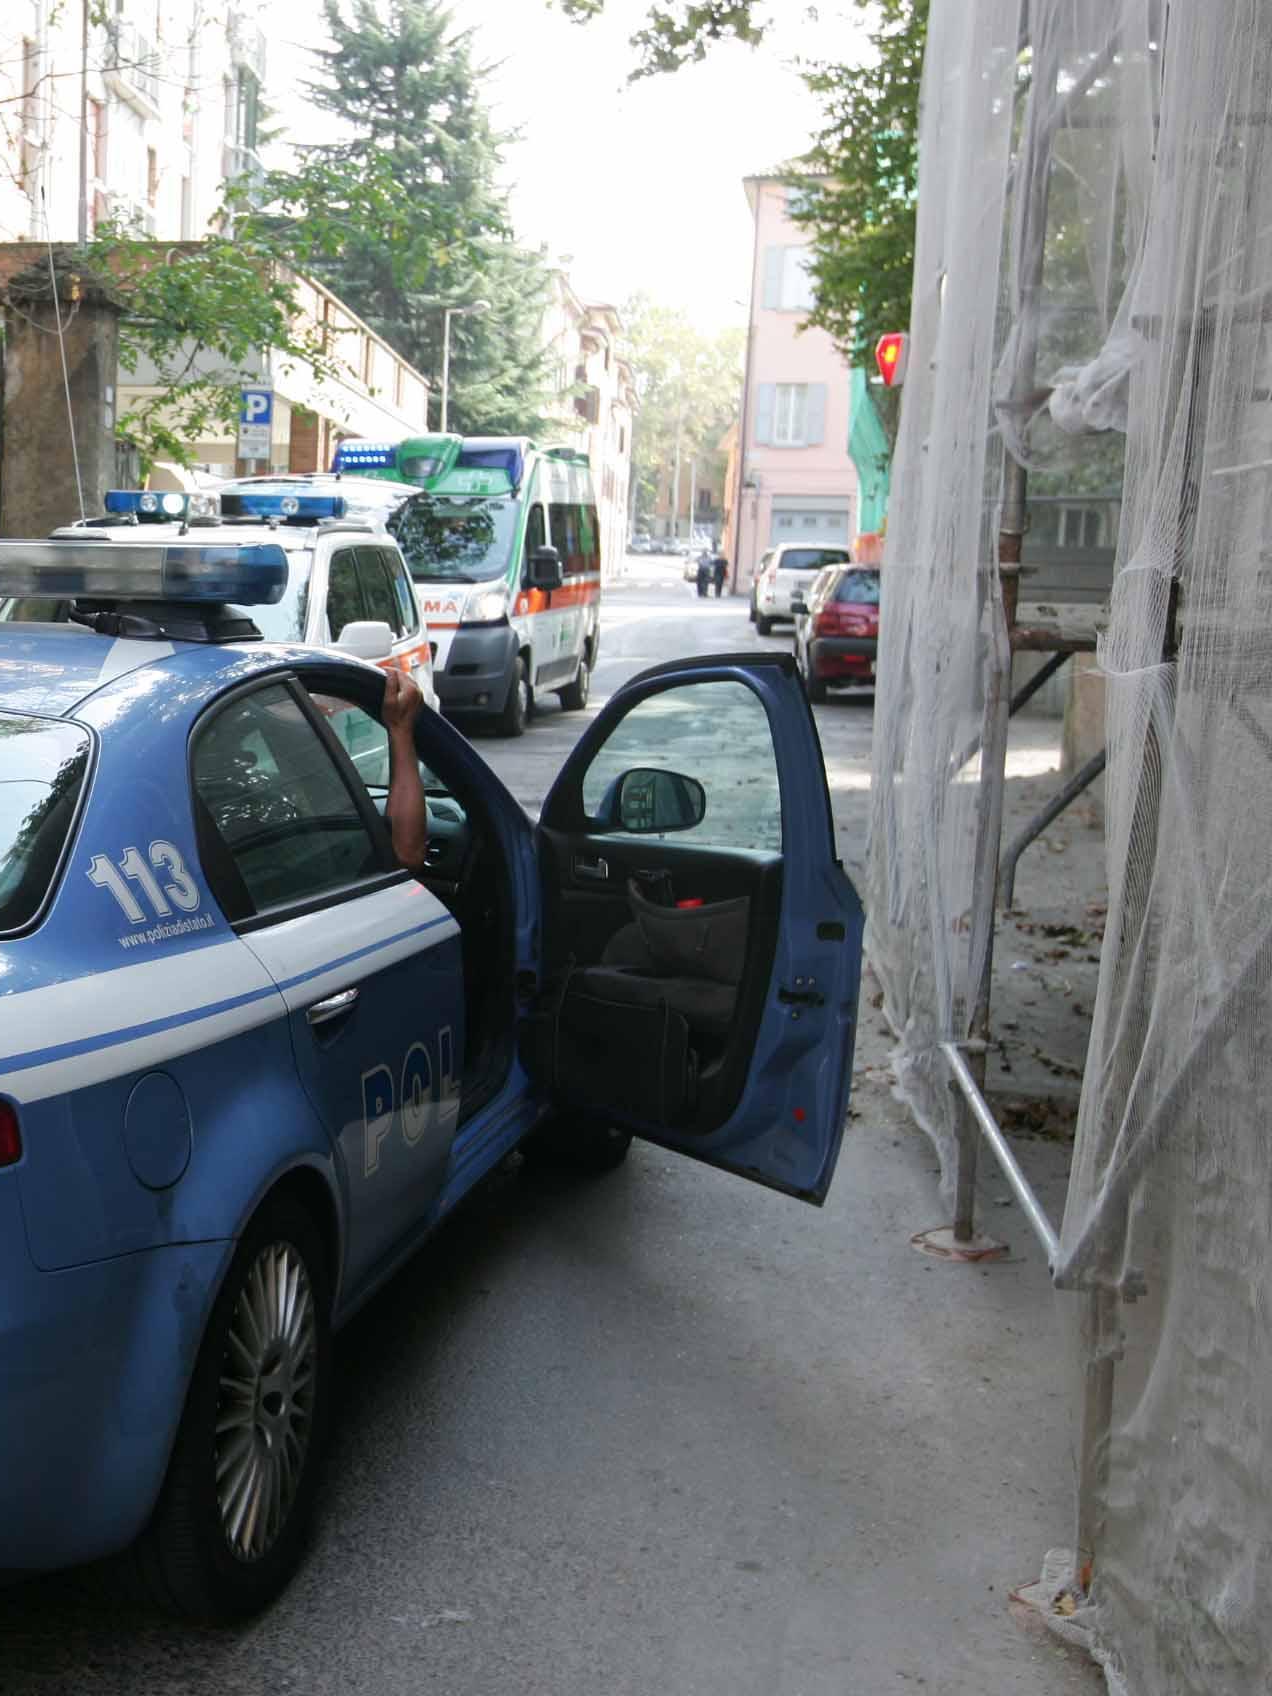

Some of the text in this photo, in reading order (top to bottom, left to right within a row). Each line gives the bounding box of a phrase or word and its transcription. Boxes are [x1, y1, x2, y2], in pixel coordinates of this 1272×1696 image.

[246, 394, 268, 421] P
[86, 840, 199, 924] 113
[118, 913, 215, 949] www.poliziadistato.it
